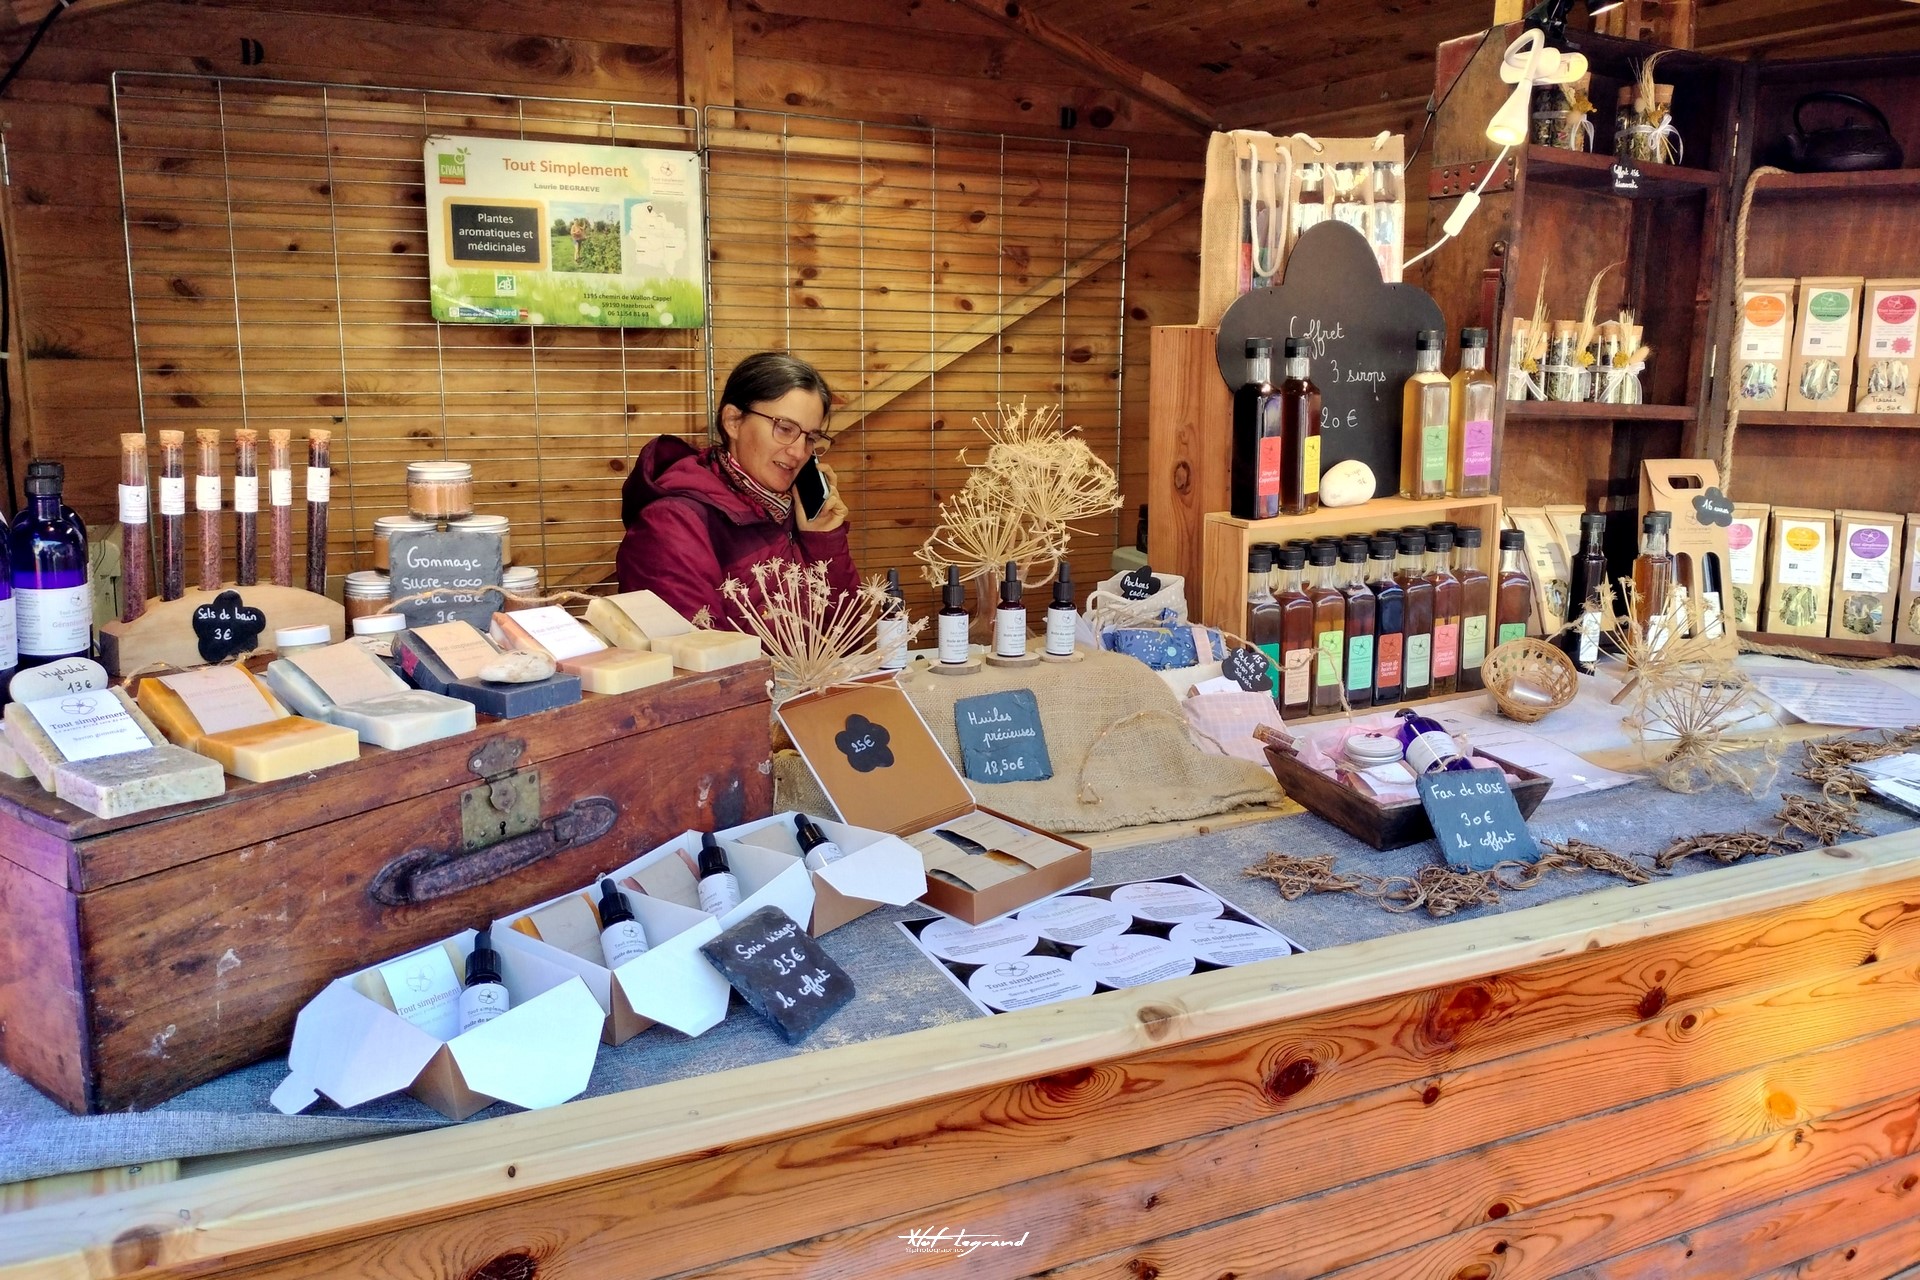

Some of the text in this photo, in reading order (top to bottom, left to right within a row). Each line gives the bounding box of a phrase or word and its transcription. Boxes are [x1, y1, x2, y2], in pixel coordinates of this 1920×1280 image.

[440, 164, 464, 176] CIVAM
[502, 158, 629, 178] Tout Simplement
[559, 184, 600, 192] DEGRAEVE
[478, 213, 514, 224] Plantes
[459, 228, 534, 239] aromatiques et
[468, 241, 526, 253] médicinales
[498, 278, 513, 290] AB
[495, 309, 517, 317] Nord
[1289, 316, 1345, 360] Coffret
[1331, 359, 1387, 393] 3 sirops
[1320, 407, 1340, 428] 20
[1702, 499, 1713, 510] 16
[406, 546, 482, 569] Gommage
[1124, 577, 1150, 590] Pochons
[431, 592, 447, 604] la
[453, 593, 484, 604] rose
[198, 607, 257, 621] Sels de bain
[437, 612, 457, 624] 9€
[214, 628, 233, 641] 3€
[1252, 653, 1267, 669] 15€
[38, 664, 88, 681] Hydrolat
[49, 721, 73, 730] Tout
[967, 711, 1012, 726] Huiles
[853, 734, 876, 754] 25€
[982, 724, 1036, 749] précieuses
[983, 757, 1026, 776] 18,50€
[1459, 780, 1475, 796] de
[1477, 782, 1506, 796] ROSE
[1456, 829, 1517, 852] le coffret
[735, 922, 797, 961] Soin visage
[1191, 931, 1259, 944] Tout simplement
[773, 947, 806, 976] 25€
[1113, 944, 1162, 964] simplement
[798, 968, 831, 997] coffret
[985, 968, 1062, 991] Tout simplement
[1008, 982, 1060, 997] Savon gommage
[398, 986, 461, 1016] Tout simplement
